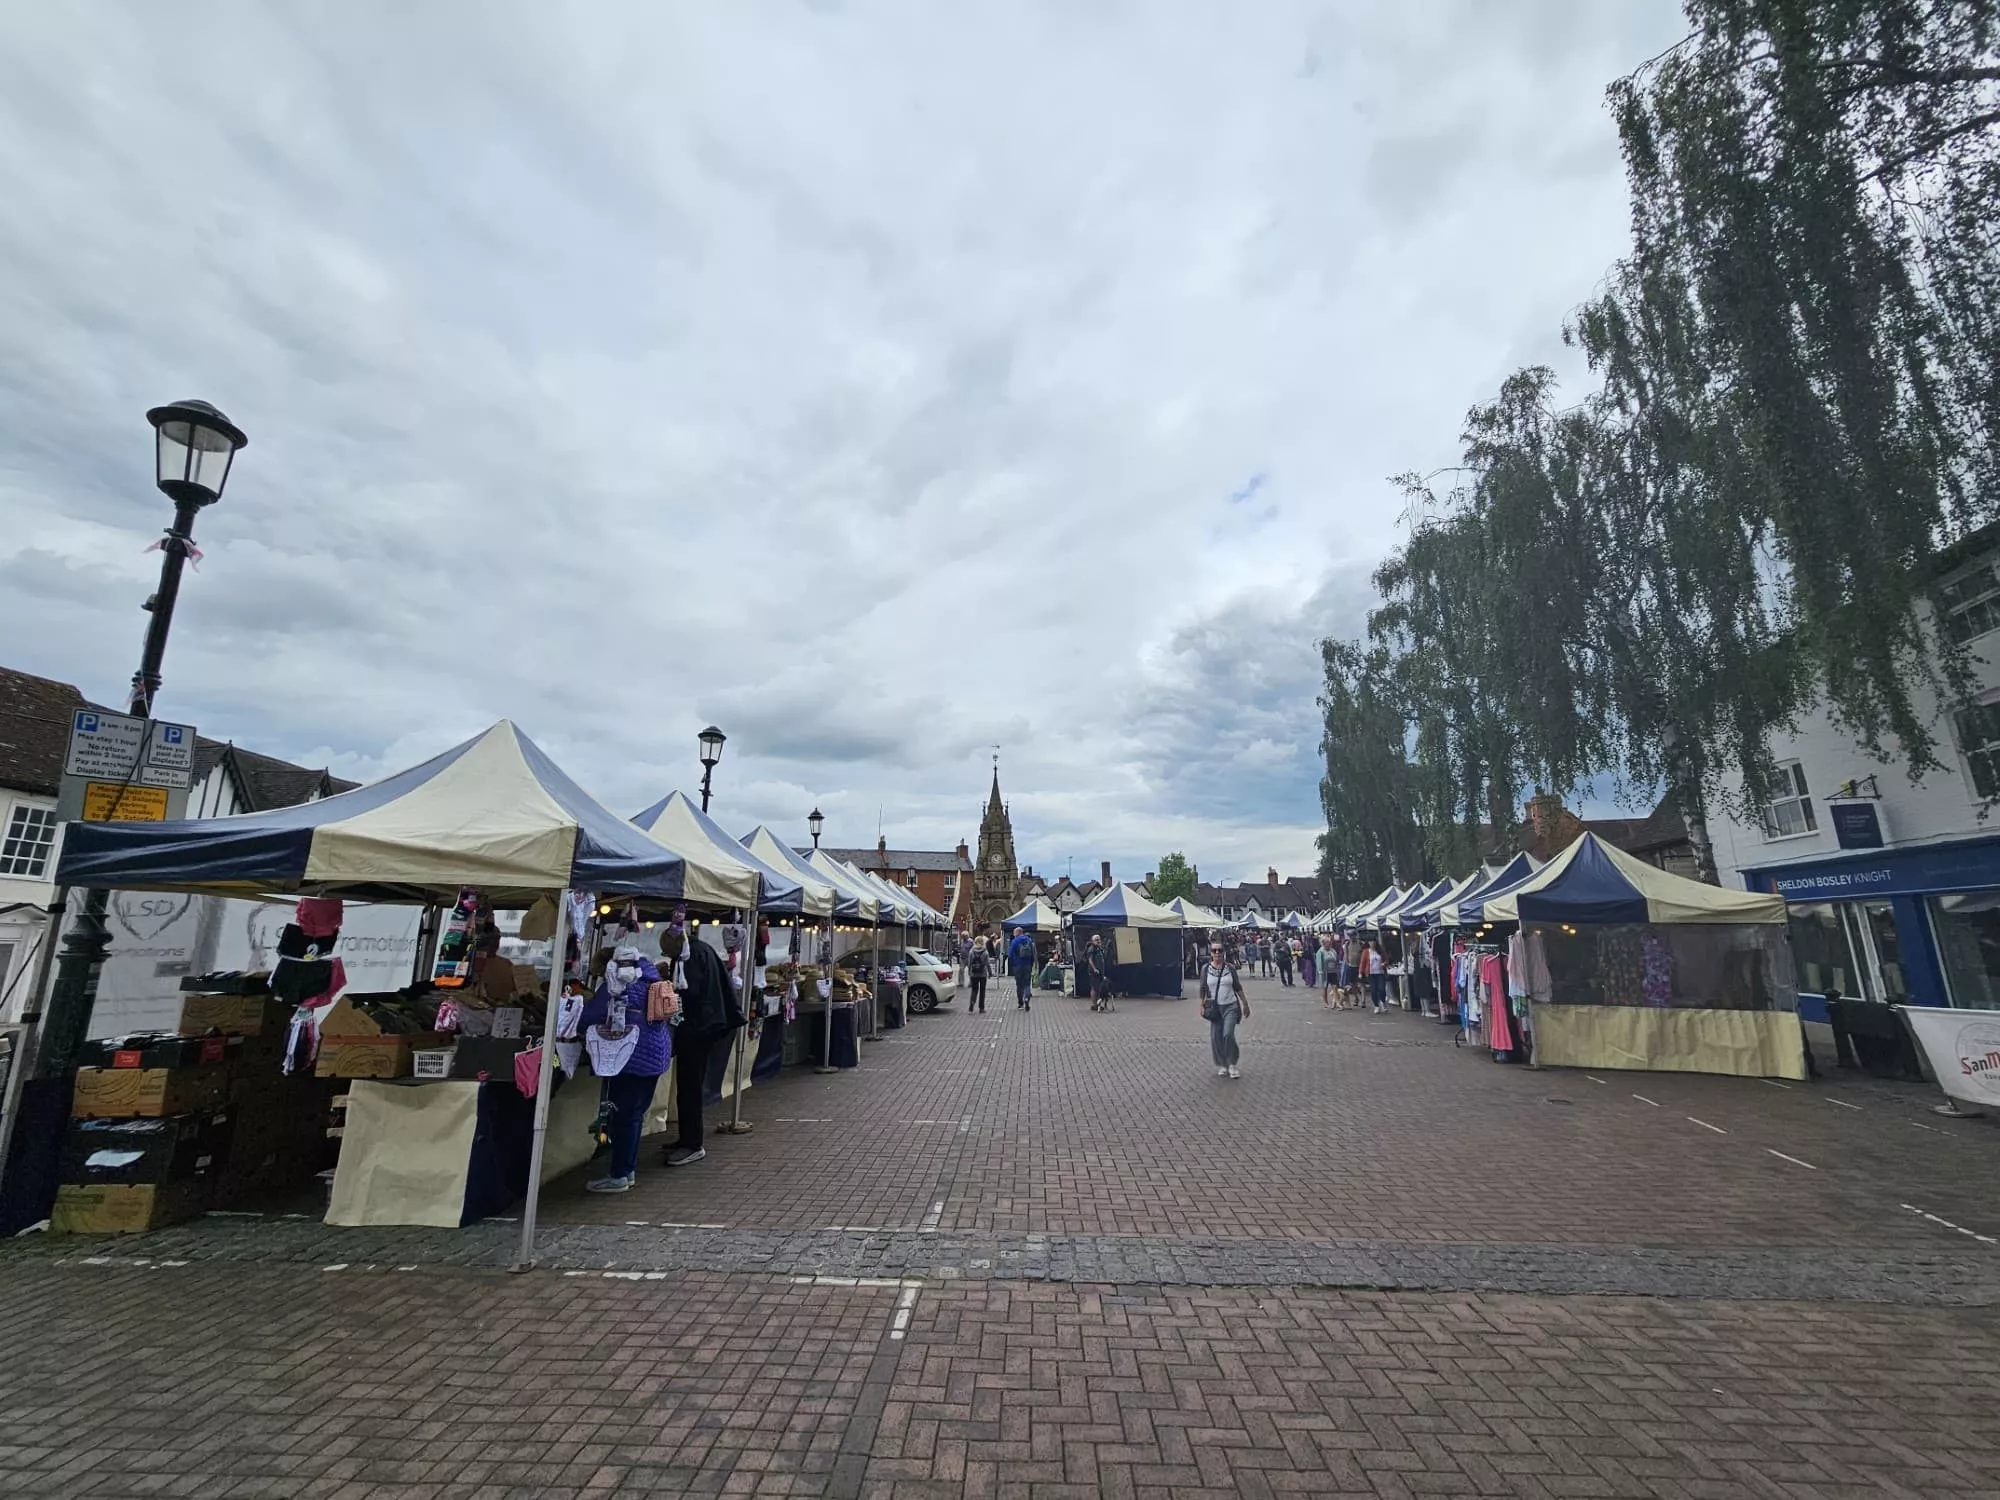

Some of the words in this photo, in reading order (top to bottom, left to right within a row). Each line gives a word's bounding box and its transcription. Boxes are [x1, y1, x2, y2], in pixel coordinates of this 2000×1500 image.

[77, 732, 94, 741] Max
[96, 736, 114, 744] stay
[88, 742, 100, 750] No
[101, 745, 126, 753] return
[111, 753, 133, 761] hours
[75, 757, 89, 766] Pay
[101, 761, 133, 769] machine
[76, 766, 105, 776] Display
[132, 795, 164, 804] Saturday
[1777, 877, 1817, 891] SHELDON
[1816, 873, 1852, 888] BOSLEY
[1853, 869, 1894, 885] KNIGHT
